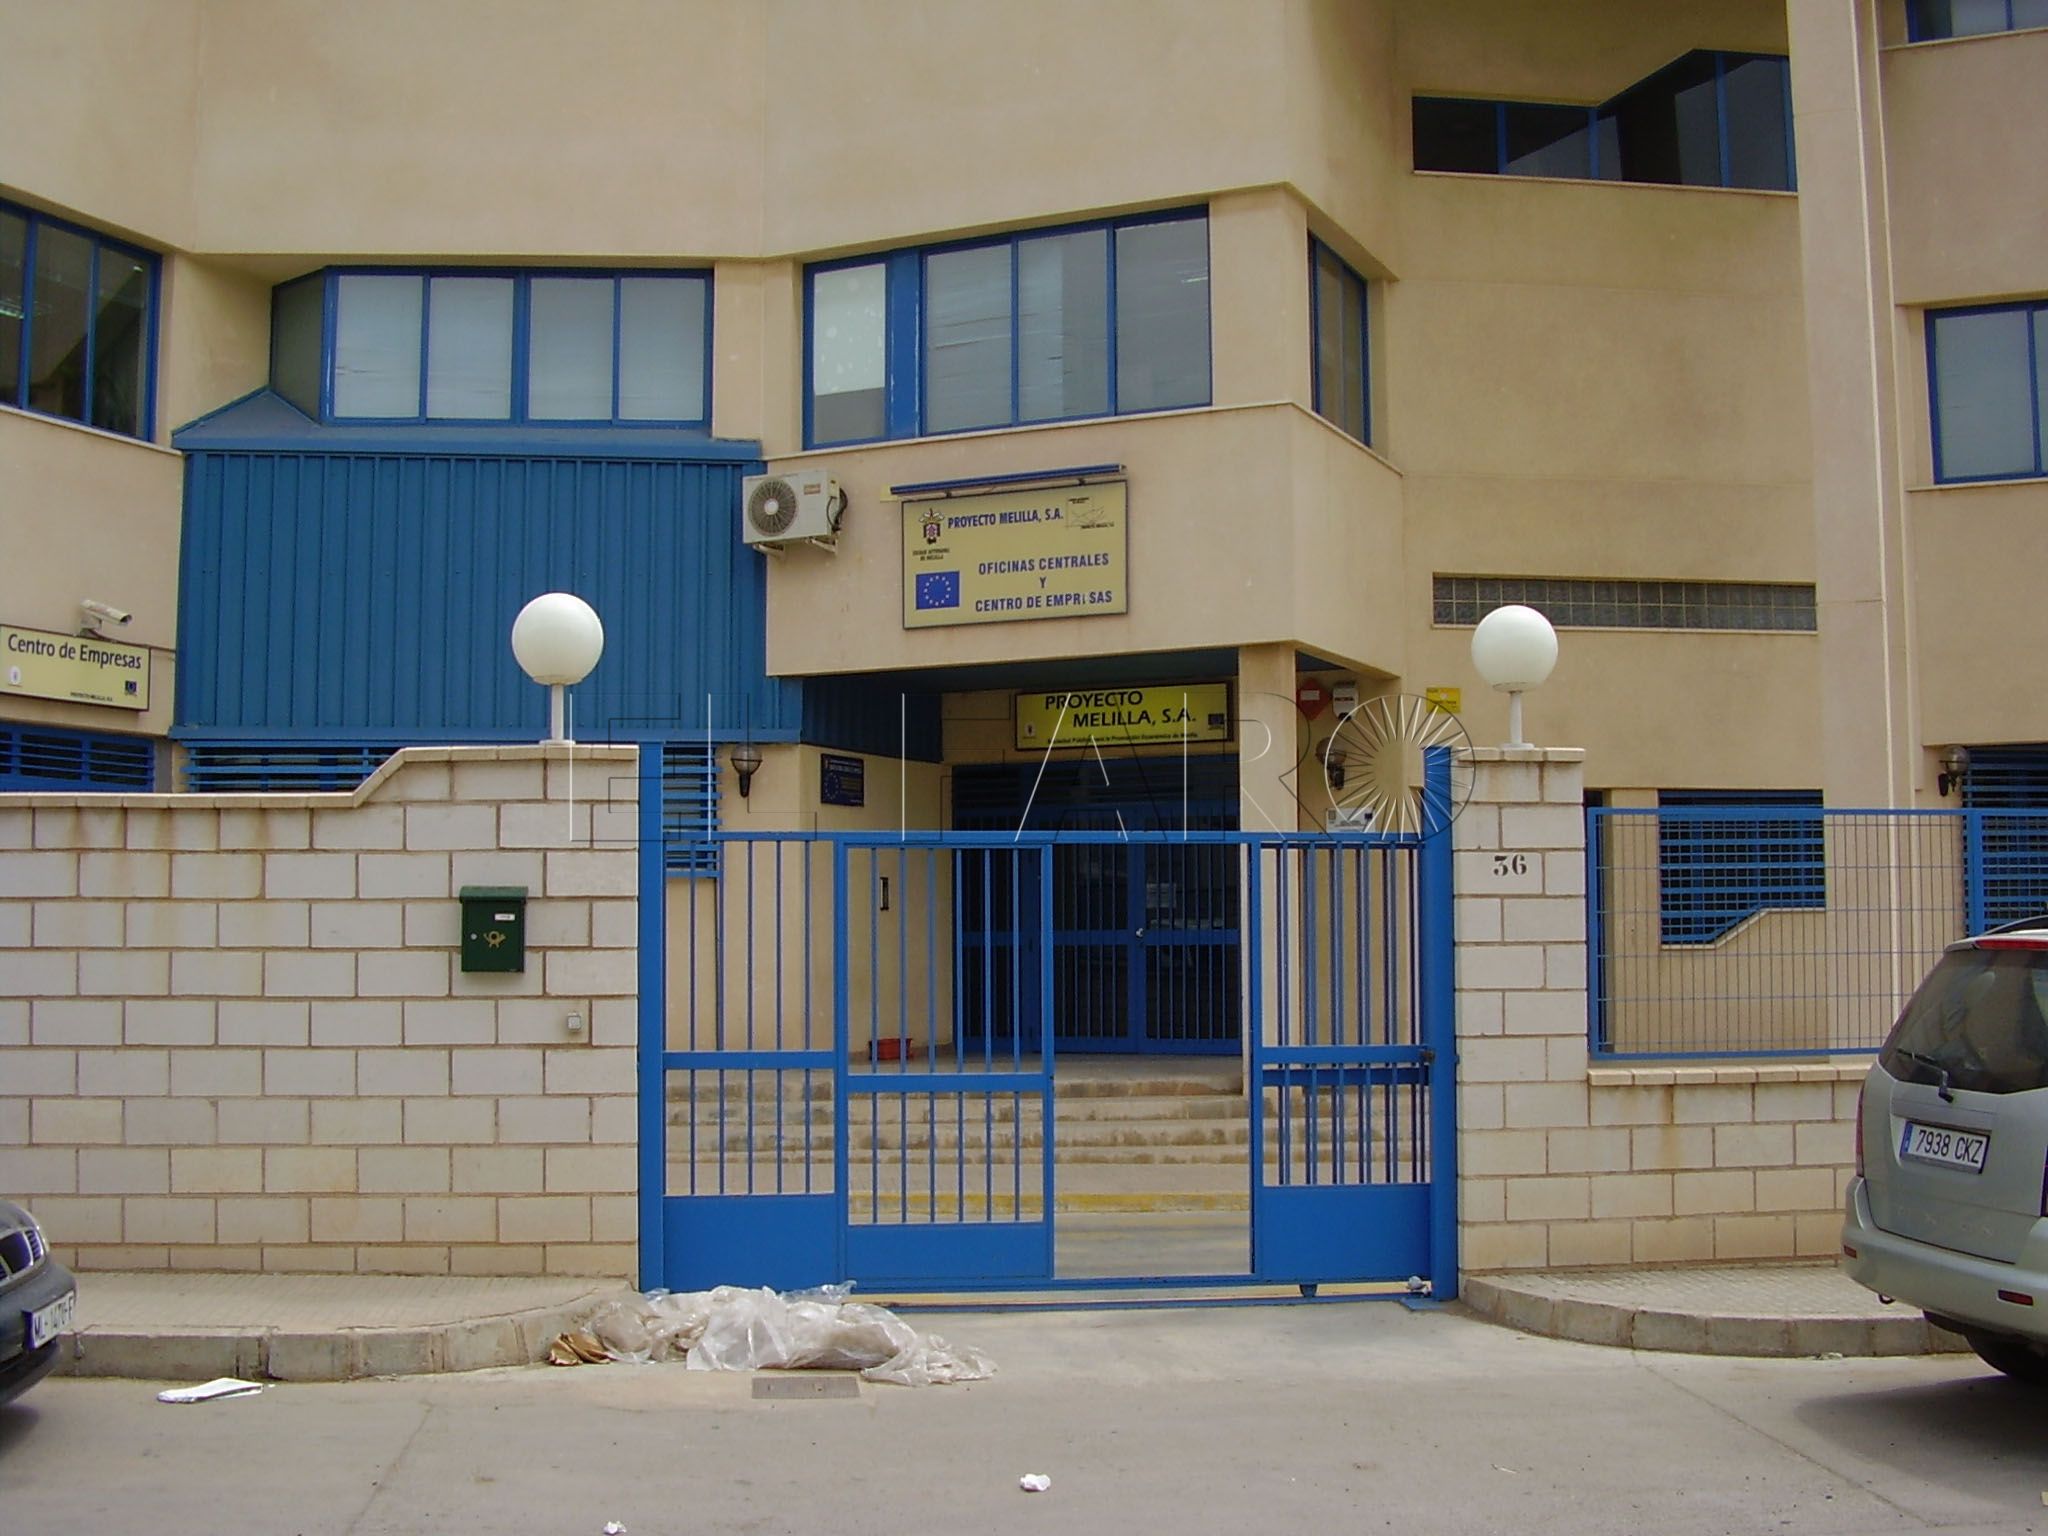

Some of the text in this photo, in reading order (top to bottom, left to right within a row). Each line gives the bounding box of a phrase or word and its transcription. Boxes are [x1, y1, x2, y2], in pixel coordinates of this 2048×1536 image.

[948, 508, 1064, 529] PROYECTO MELILLA, S.A.
[978, 553, 1110, 575] OFICINAS CENTRALES
[1039, 576, 1047, 589] Y
[975, 590, 1113, 612] CENTRO DE EMPRSAS
[8, 633, 142, 669] Centro de Empresas
[1045, 691, 1143, 710] PROYECTO
[1073, 708, 1196, 728] MELILLA, S.A.
[1493, 854, 1527, 876] 36
[1916, 1129, 1984, 1164] 7938 CKZ
